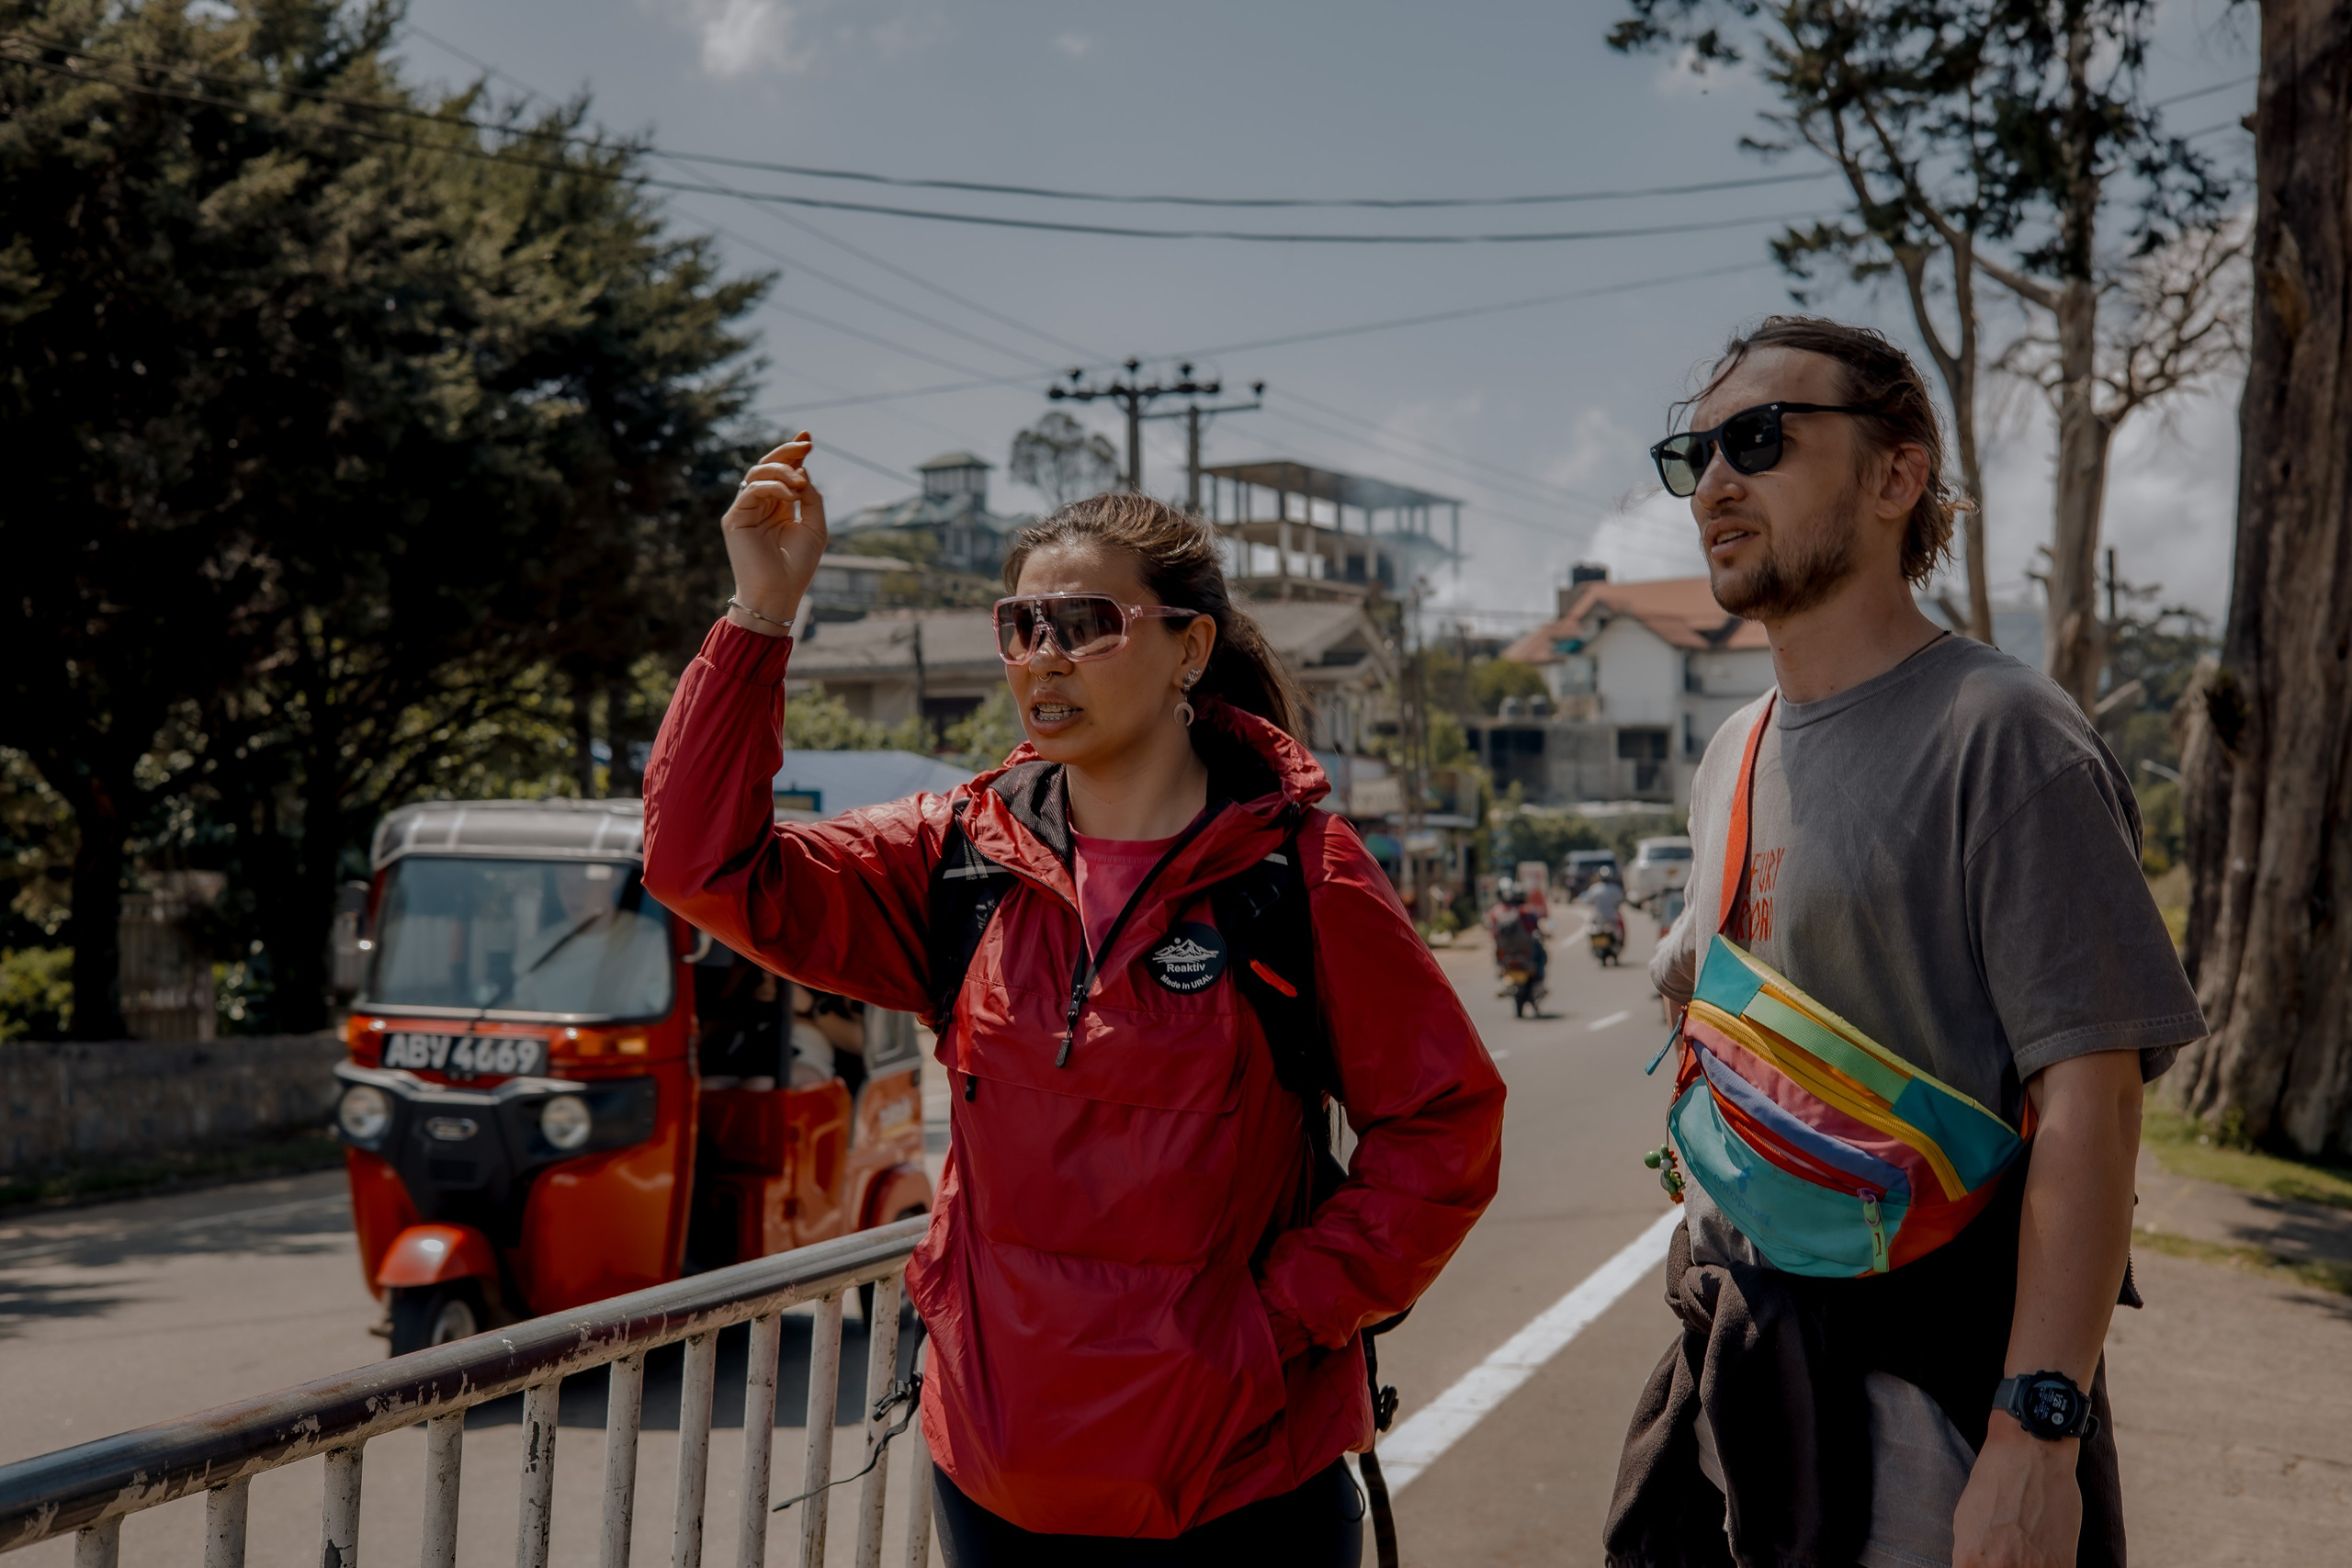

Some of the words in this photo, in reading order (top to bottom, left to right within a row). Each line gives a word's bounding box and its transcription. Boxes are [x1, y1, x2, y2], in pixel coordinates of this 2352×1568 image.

[1746, 847, 1785, 895] FURY
[1734, 896, 1774, 942] ROAD
[1160, 974, 1181, 989] Made
[1191, 974, 1213, 989] URAL
[1167, 963, 1205, 973] Reaktiv
[451, 1036, 540, 1074] 4669
